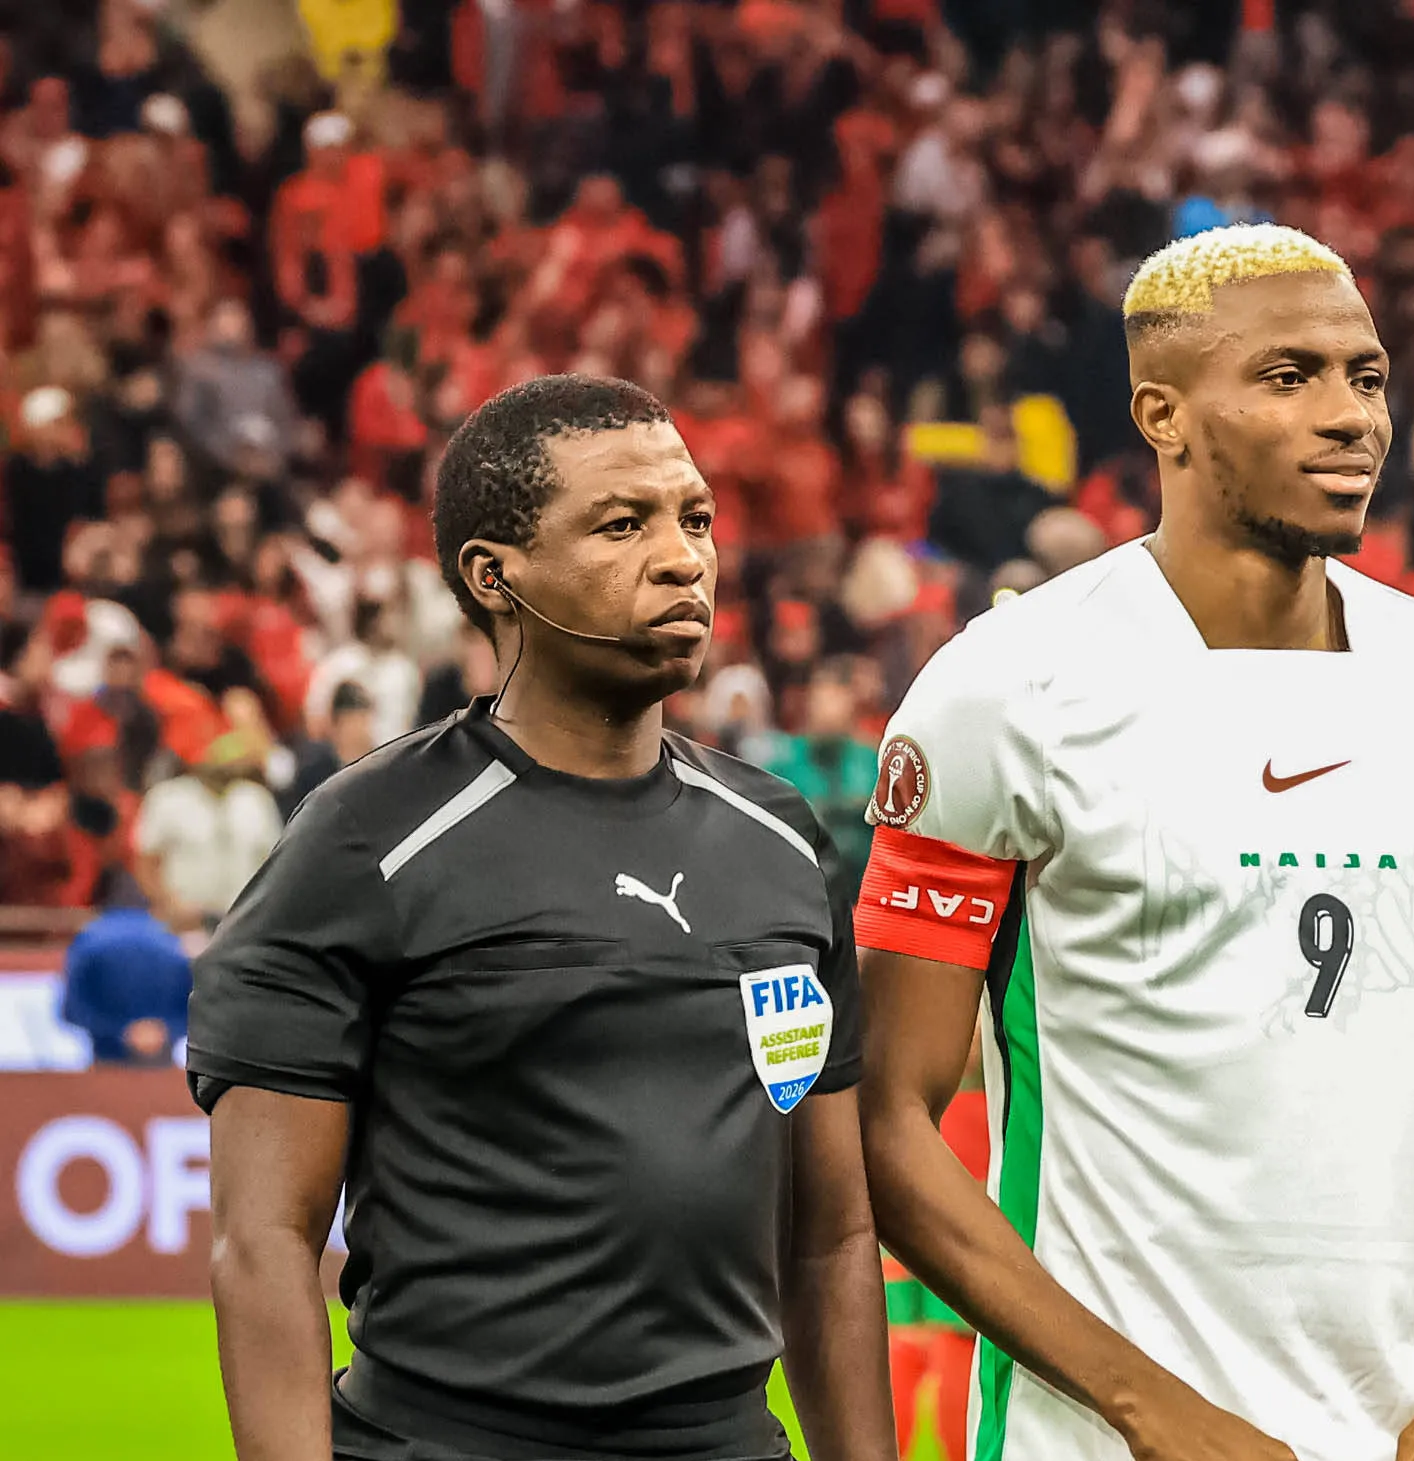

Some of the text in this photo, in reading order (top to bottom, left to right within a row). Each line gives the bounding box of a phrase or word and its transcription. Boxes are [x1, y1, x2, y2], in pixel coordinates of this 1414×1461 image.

[916, 773, 924, 794] CUP
[1240, 853, 1397, 869] NAIJA
[891, 885, 995, 925] CAF
[1298, 893, 1354, 1018] 9
[751, 975, 824, 1017] FIFA
[760, 1023, 825, 1049] ASSISTANT
[766, 1041, 820, 1066] REFEREE
[778, 1081, 805, 1101] 2026
